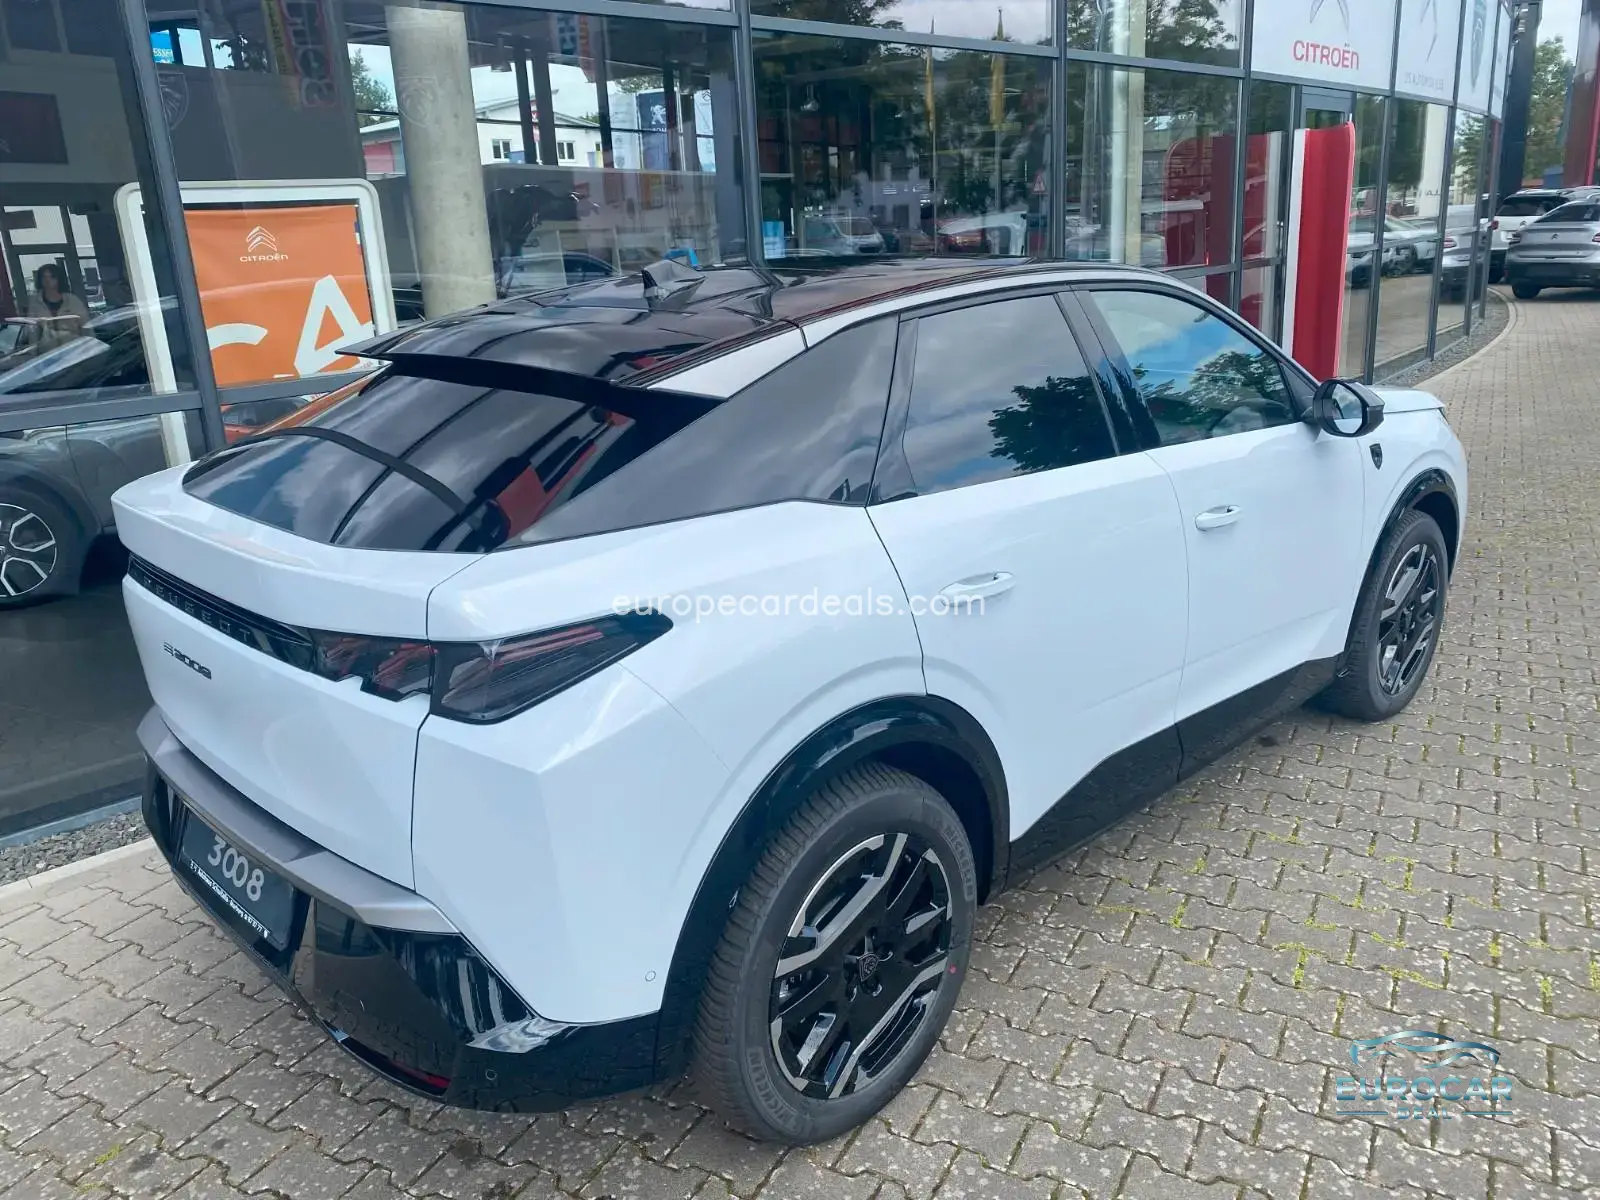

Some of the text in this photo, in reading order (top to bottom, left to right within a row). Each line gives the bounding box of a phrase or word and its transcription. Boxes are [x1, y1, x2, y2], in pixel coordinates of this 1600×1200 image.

[1293, 40, 1360, 71] CITROËN
[239, 253, 289, 263] CITROËN
[143, 575, 250, 642] PEUGEOT
[207, 833, 265, 902] 3008
